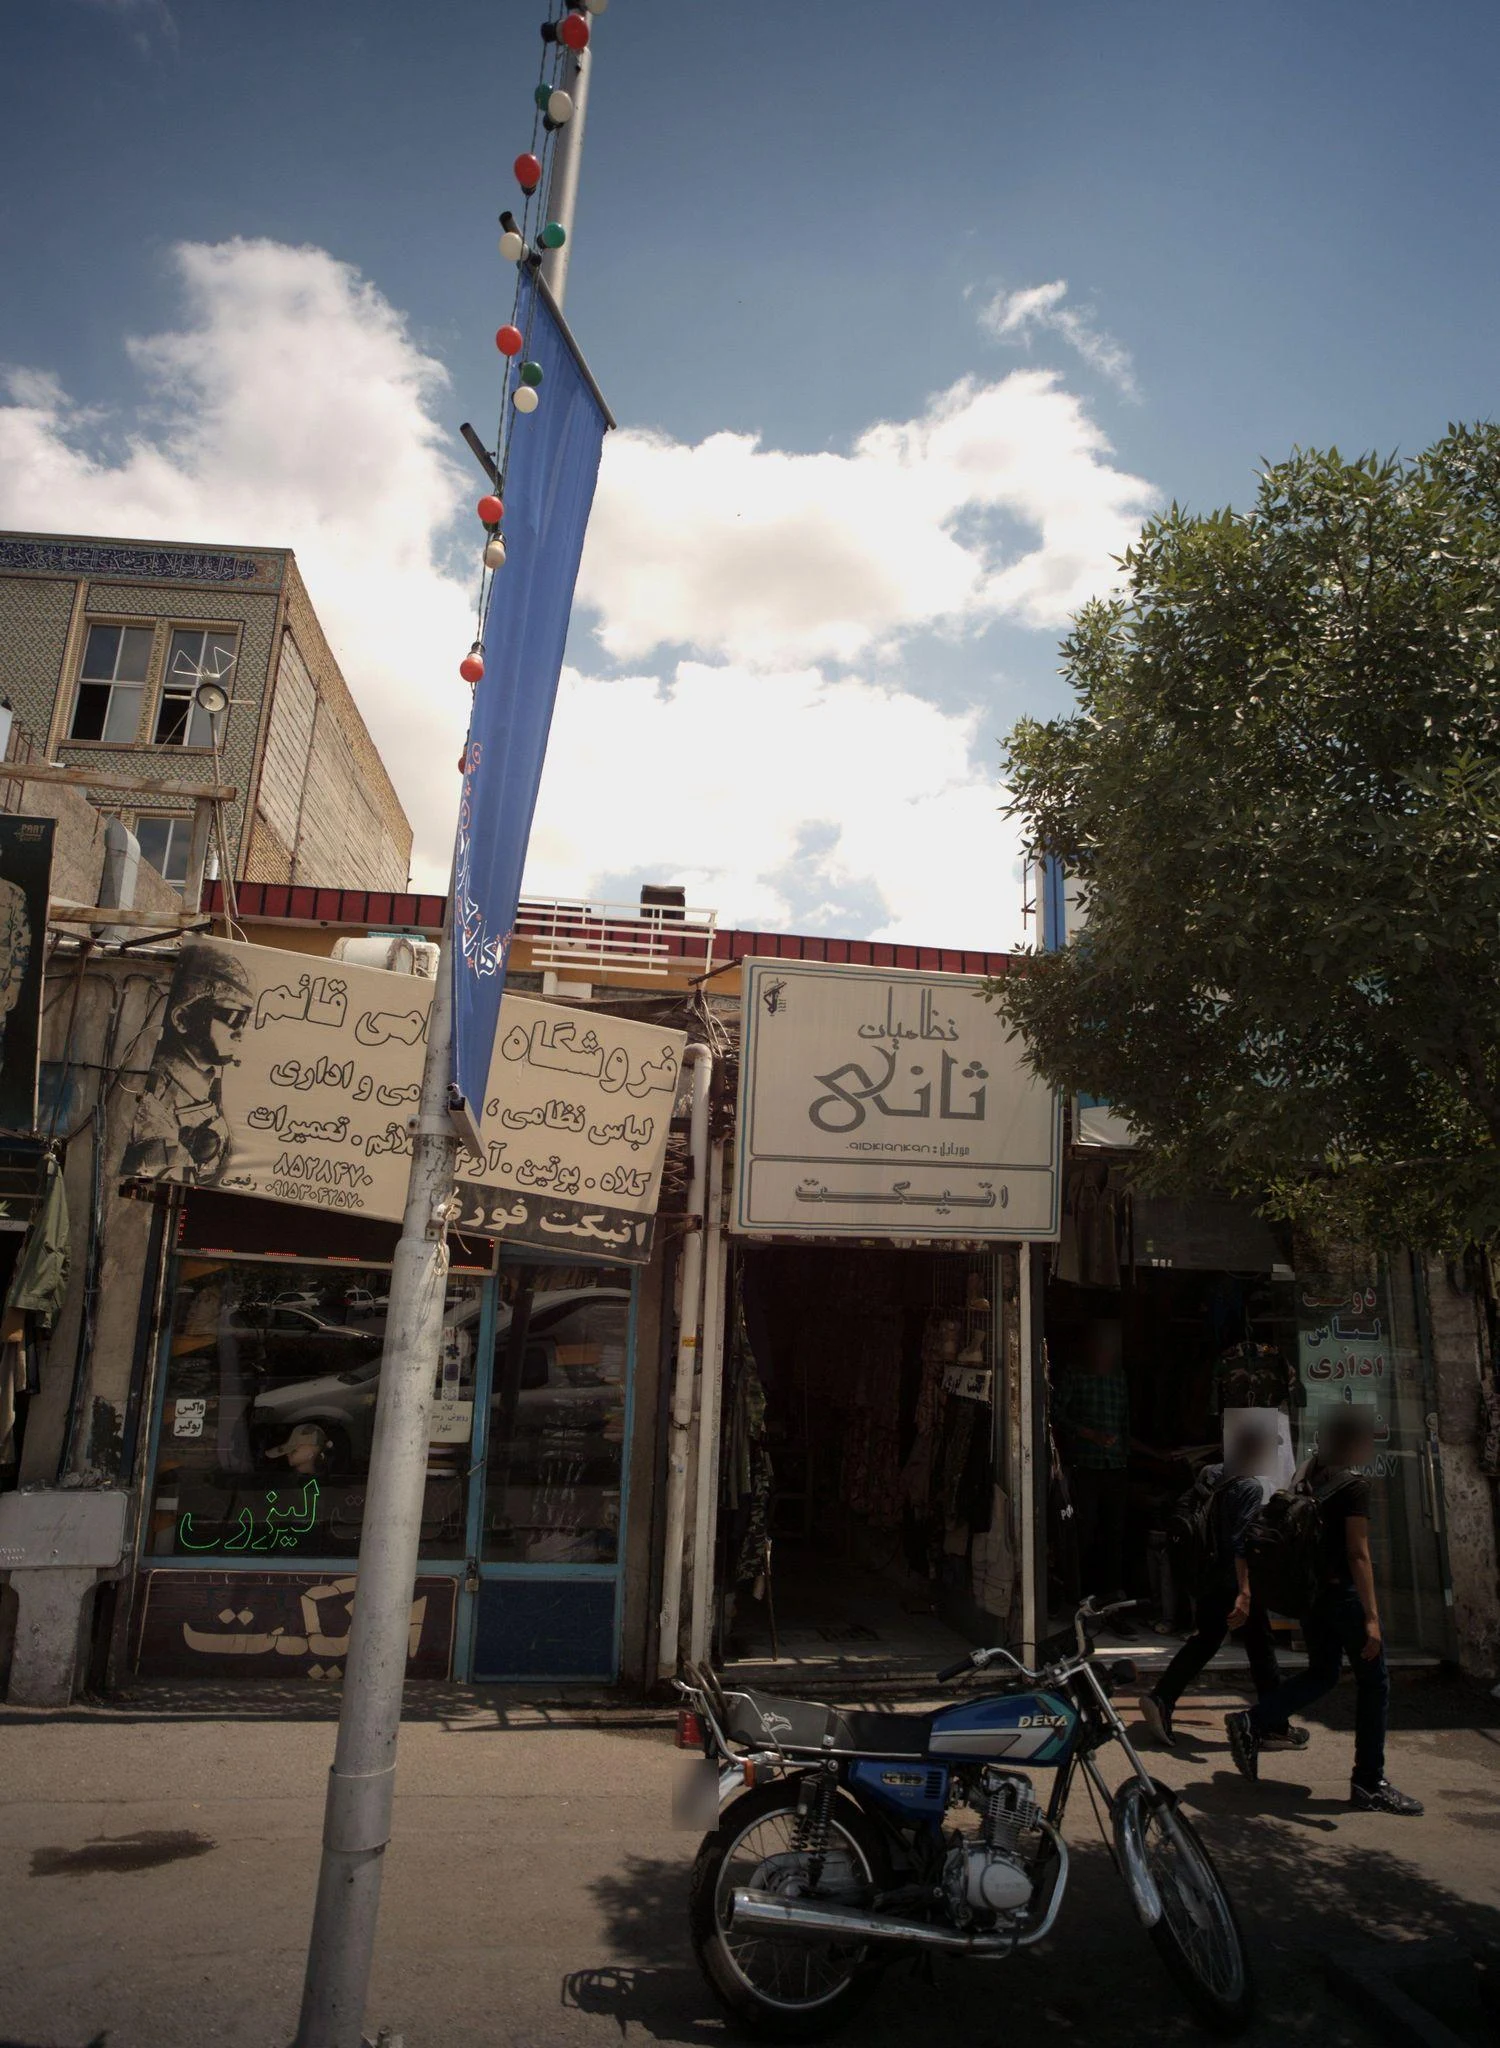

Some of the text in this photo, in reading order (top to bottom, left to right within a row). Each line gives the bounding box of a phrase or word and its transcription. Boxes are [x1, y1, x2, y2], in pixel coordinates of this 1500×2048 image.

[255, 974, 348, 1030] قائم
[858, 986, 960, 1050] نظامیات
[269, 1056, 354, 1091] اداری
[501, 1020, 678, 1098] فروشگاه
[352, 1075, 374, 1101] و
[247, 1105, 350, 1144] تعمیرات
[588, 1114, 654, 1151] لباس
[272, 1152, 374, 1187] ۸۵۲۸۴۷۰
[516, 1156, 581, 1195] پوتین
[600, 1165, 652, 1197] کلاه
[795, 1179, 1009, 1216] اتیکت
[540, 1211, 647, 1249] اتیکت
[1306, 1314, 1382, 1353] لباس
[1307, 1352, 1385, 1381] اداری
[177, 1401, 205, 1415] واکس
[181, 1576, 428, 1681] ایکت
[1018, 1714, 1068, 1729] DELTA
